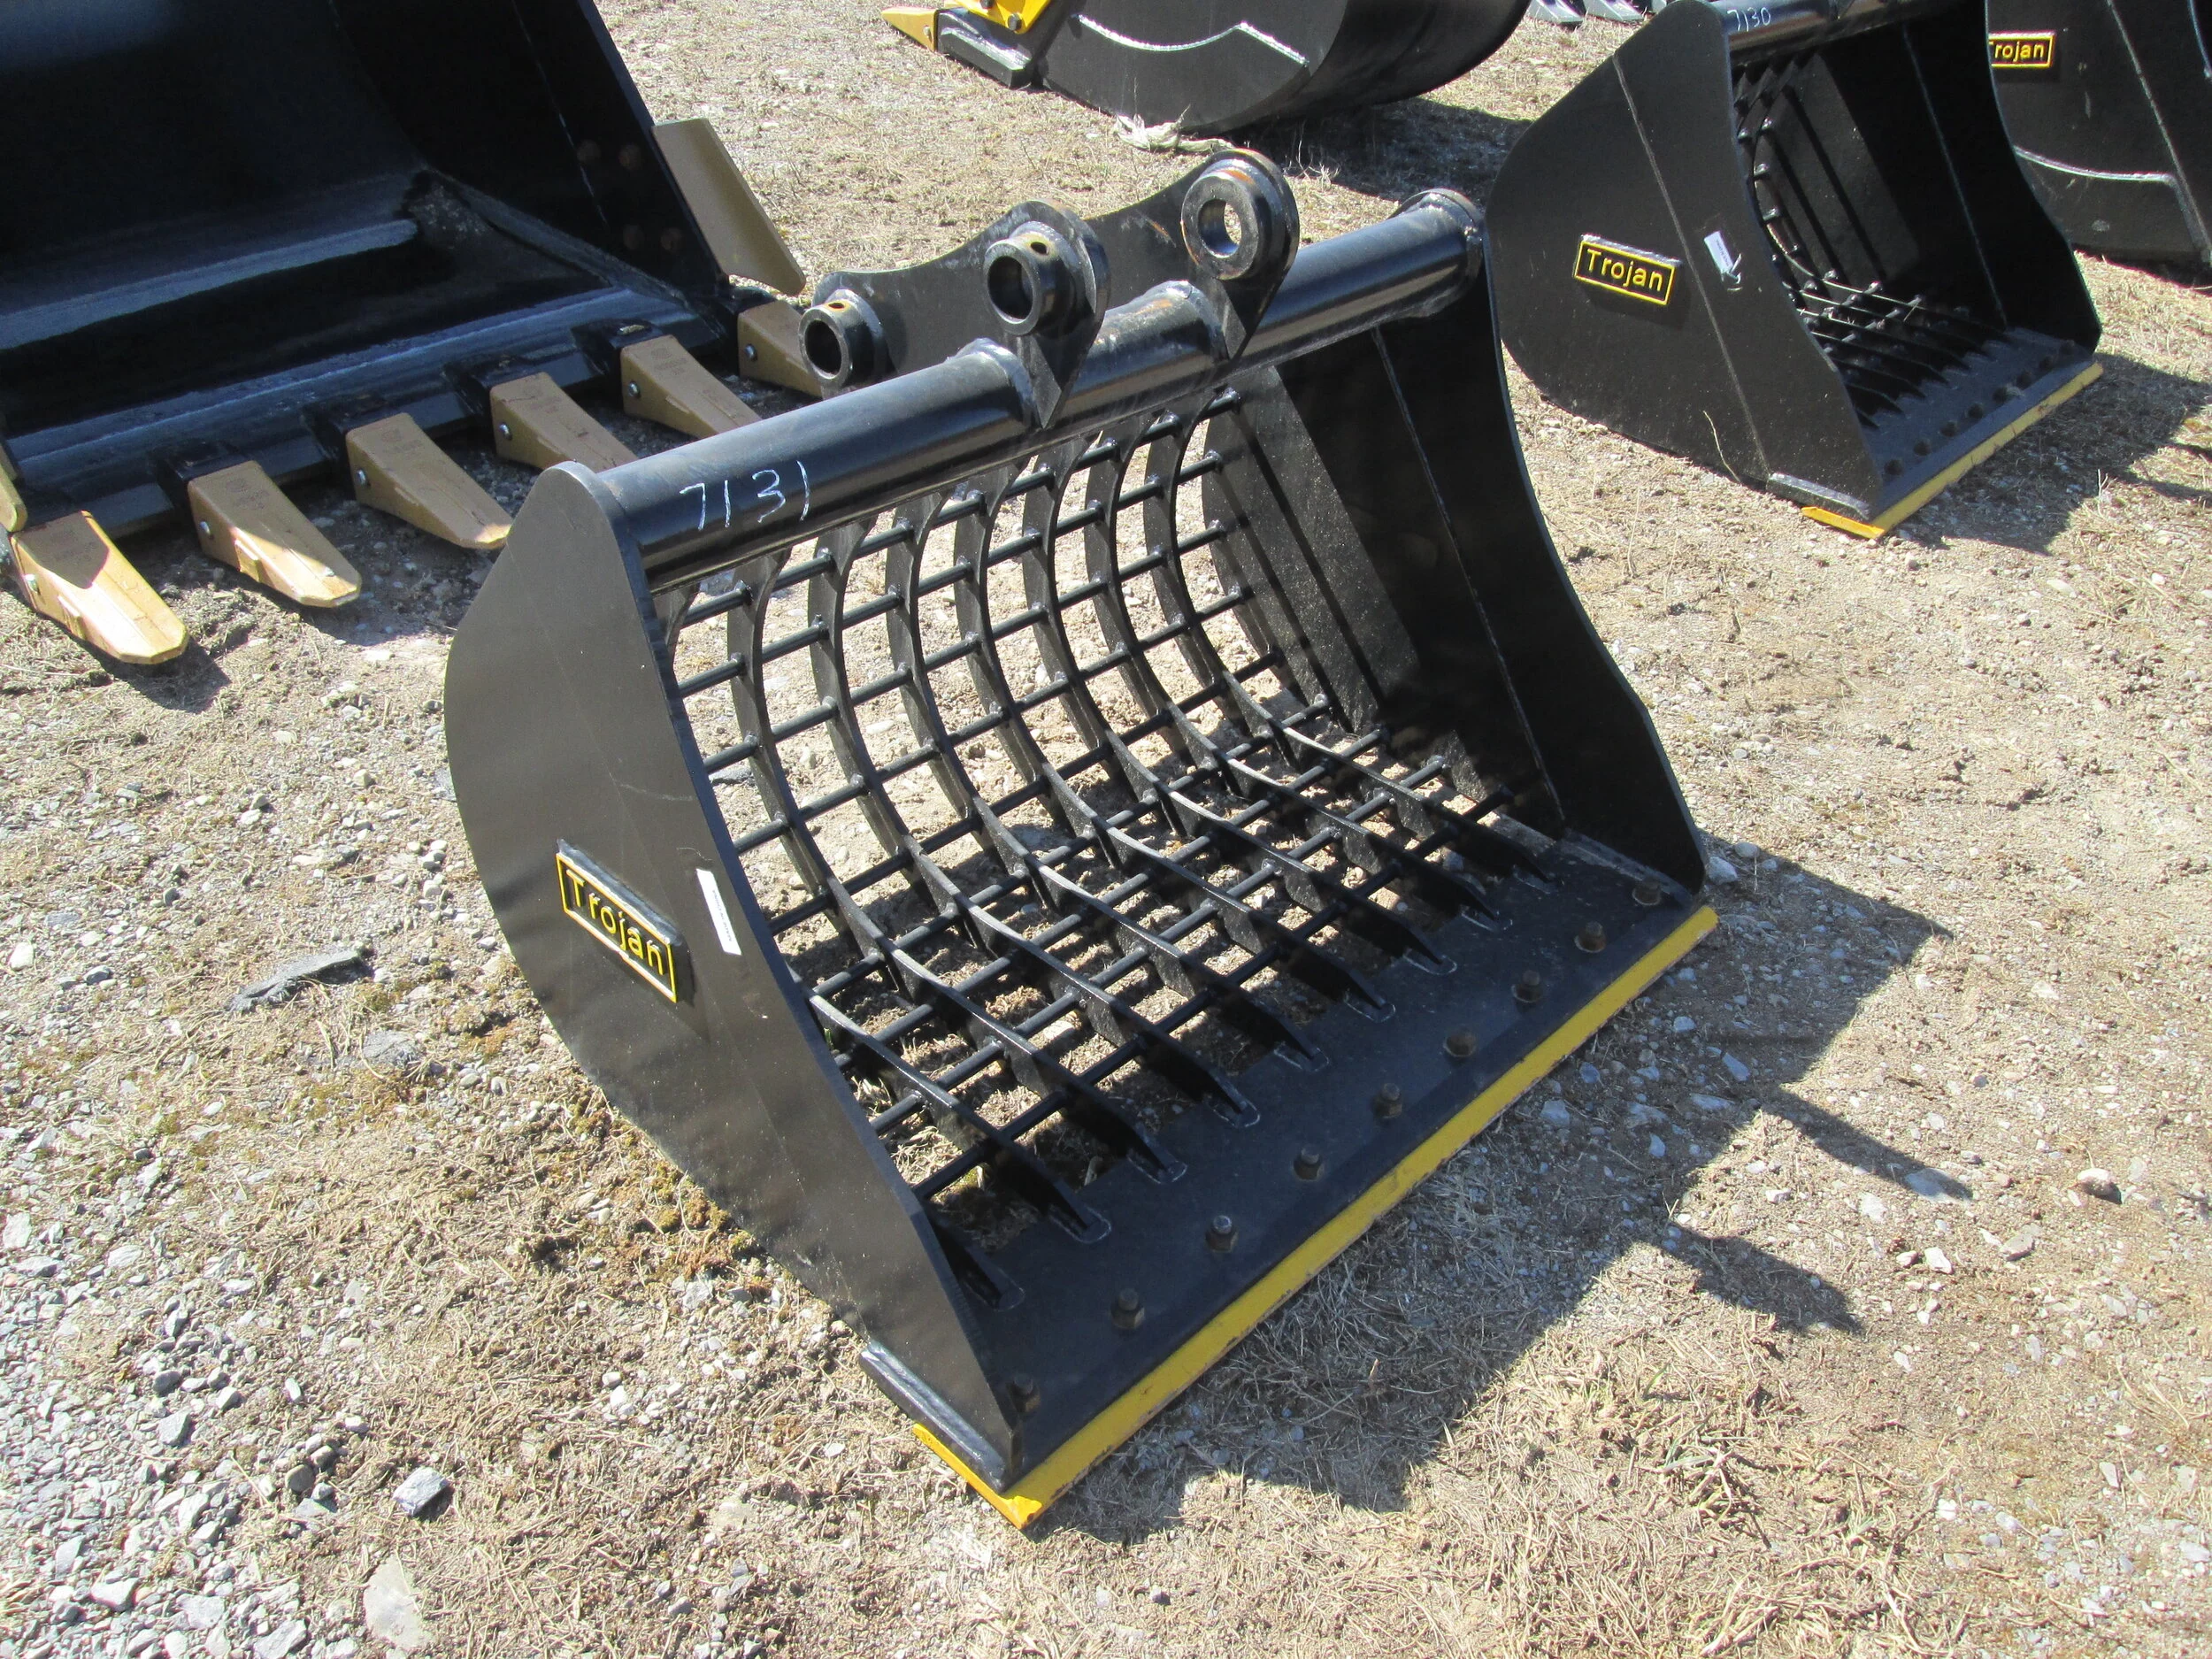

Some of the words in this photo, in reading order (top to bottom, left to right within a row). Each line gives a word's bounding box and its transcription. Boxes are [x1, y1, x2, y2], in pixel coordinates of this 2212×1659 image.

[1726, 6, 1771, 33] 7130
[1586, 248, 1663, 292] Trojan
[679, 460, 810, 531] 7131
[565, 869, 664, 976] Trojan
